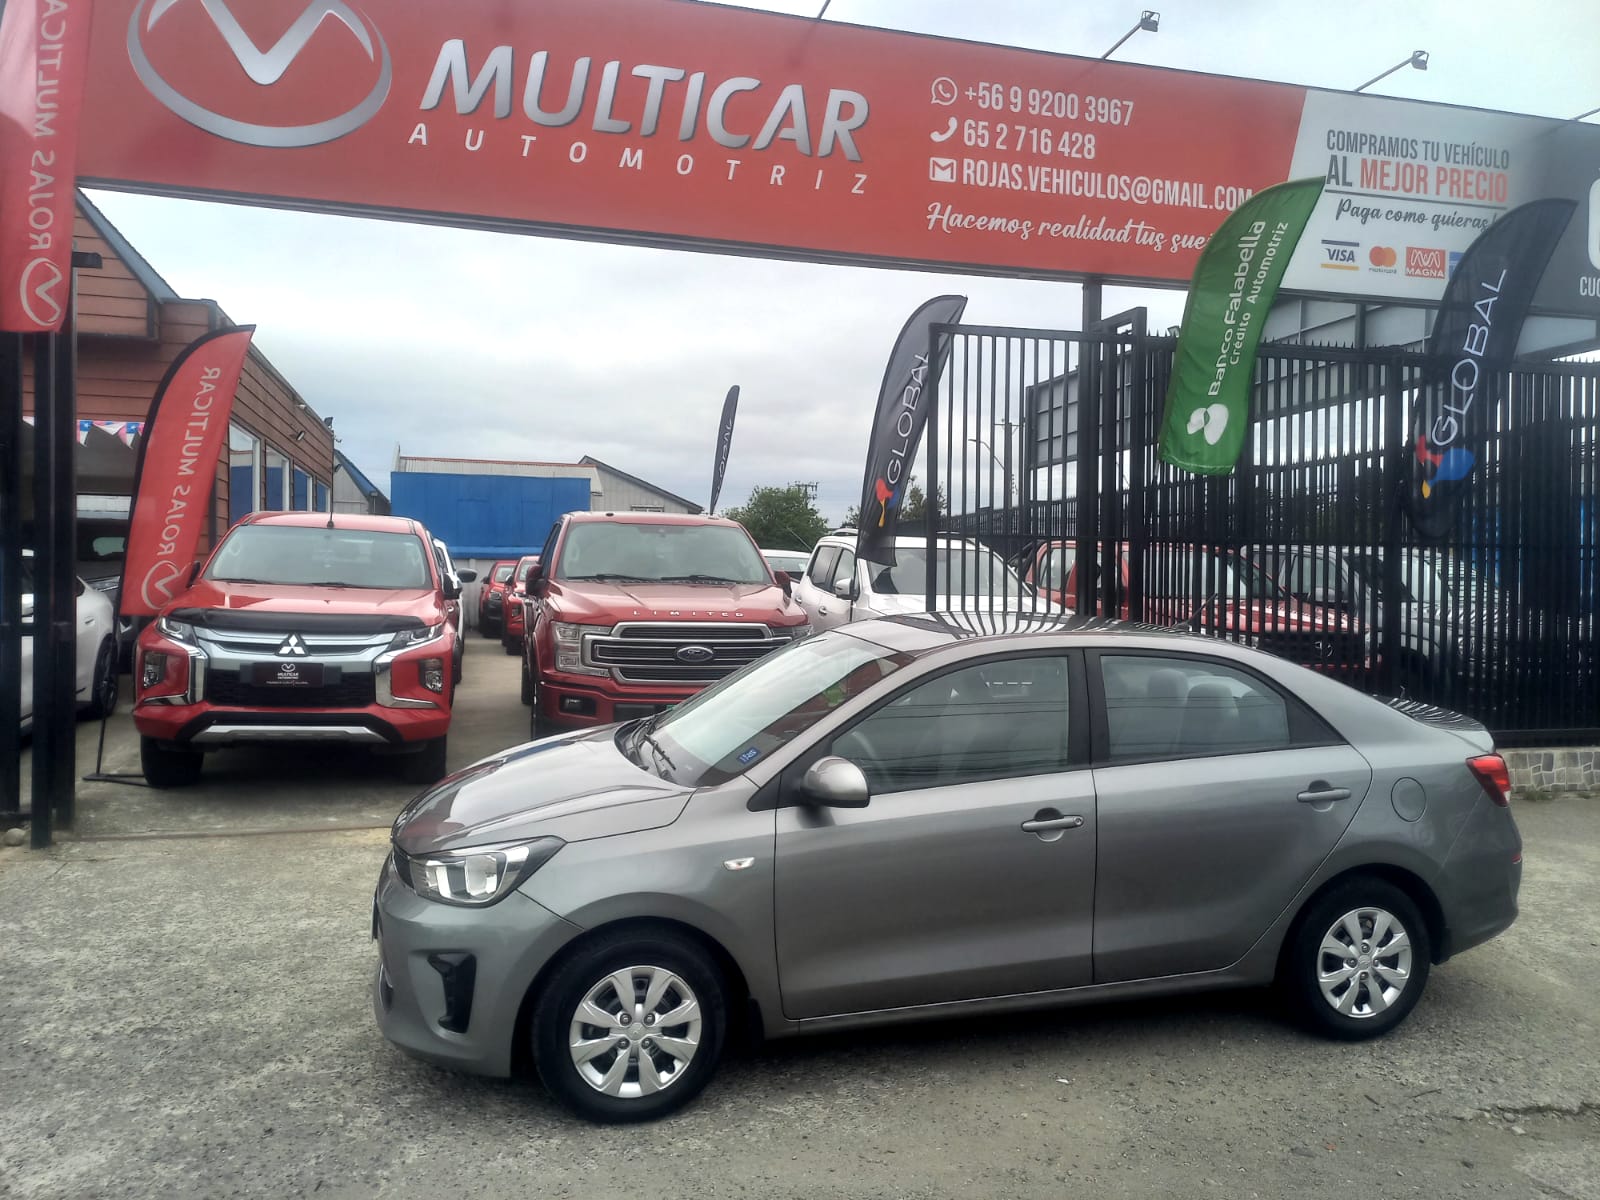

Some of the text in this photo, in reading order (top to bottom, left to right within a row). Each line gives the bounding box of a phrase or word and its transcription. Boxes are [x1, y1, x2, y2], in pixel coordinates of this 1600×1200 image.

[419, 38, 870, 162] MULTICAR
[964, 82, 1135, 126] +56 9 9200 3967
[408, 122, 868, 195] AUTOMOTRIZ
[963, 119, 1096, 160] 65 2 716 428
[1326, 129, 1510, 170] COMPRAMOS TU VEHÍCULO
[1326, 154, 1509, 203] AL MEJOR PRECIO
[926, 202, 1035, 241] Hacemos
[1038, 213, 1136, 244] realidad
[1126, 219, 1167, 252] tus
[1335, 198, 1383, 225] Paga
[1385, 209, 1427, 225] como
[1326, 248, 1356, 263] VISA
[1406, 267, 1444, 278] MAGNA
[1230, 221, 1289, 365] Crédito Automotriz
[1431, 268, 1507, 446] GLOBAL
[887, 353, 930, 485] GLOBAL
